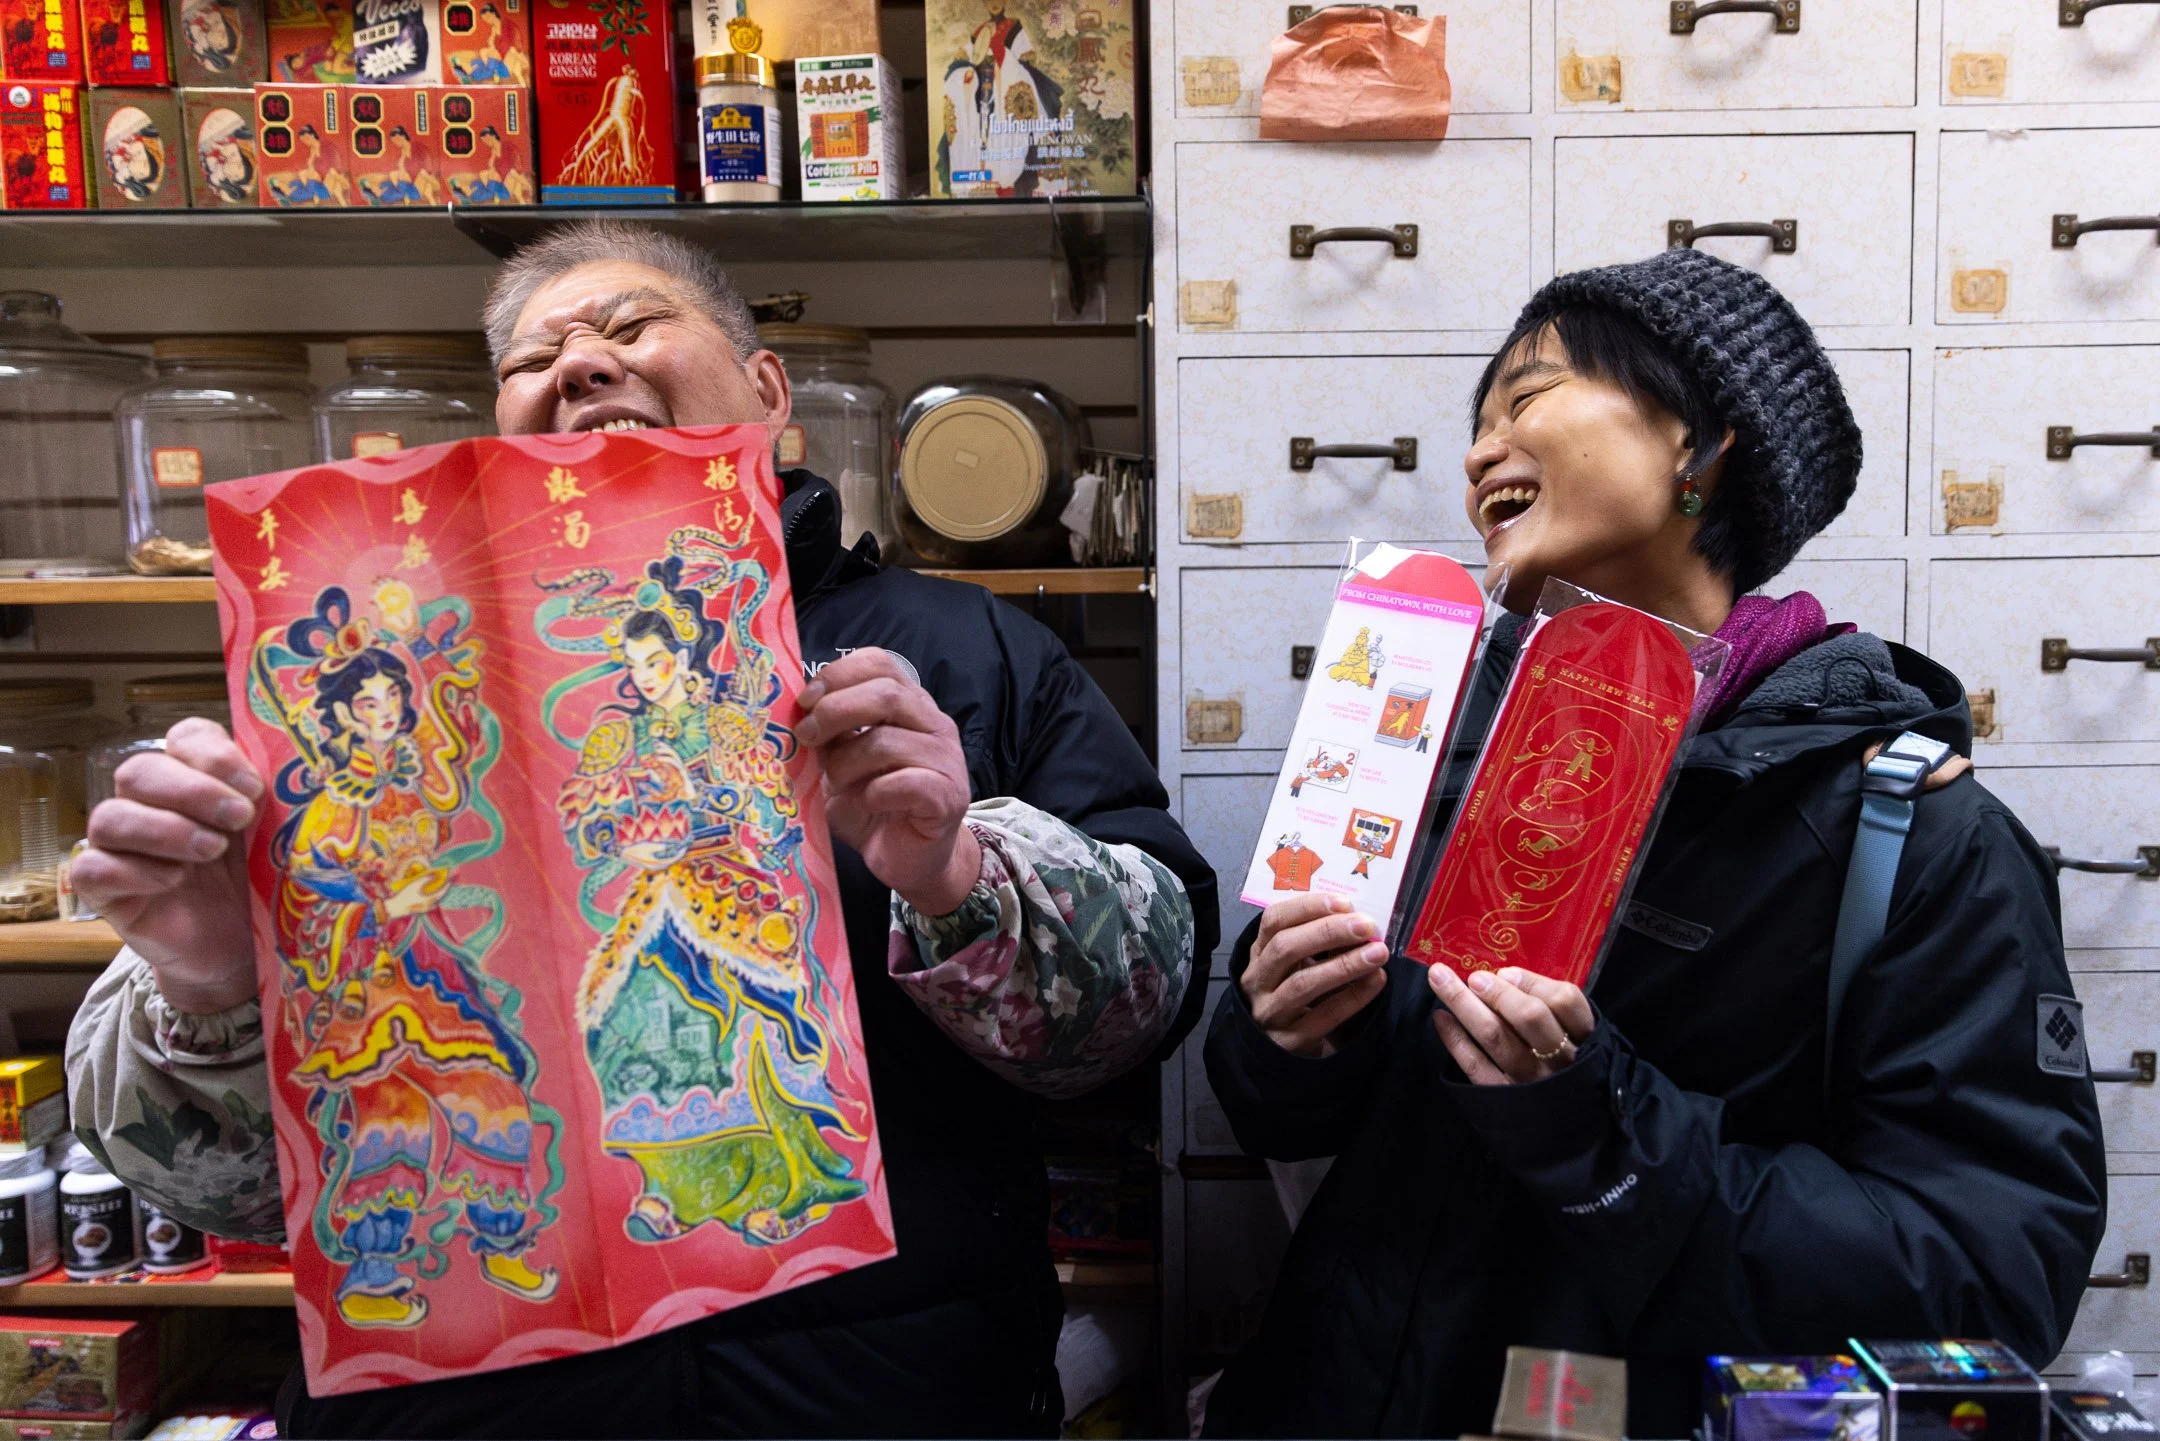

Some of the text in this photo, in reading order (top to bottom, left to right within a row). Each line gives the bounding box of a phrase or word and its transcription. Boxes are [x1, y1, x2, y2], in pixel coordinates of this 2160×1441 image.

[545, 23, 599, 40] 고려인삼
[549, 52, 598, 66] KOREAN
[549, 65, 598, 79] GINSENG
[807, 161, 877, 178] Cordyceps Pills
[1341, 587, 1473, 619] FROM CHINATOWN, WITH LOVE
[1559, 667, 1657, 710] HAPPY NEW YEAR
[1346, 752, 1356, 765] 2
[1467, 789, 1486, 821] WOOD
